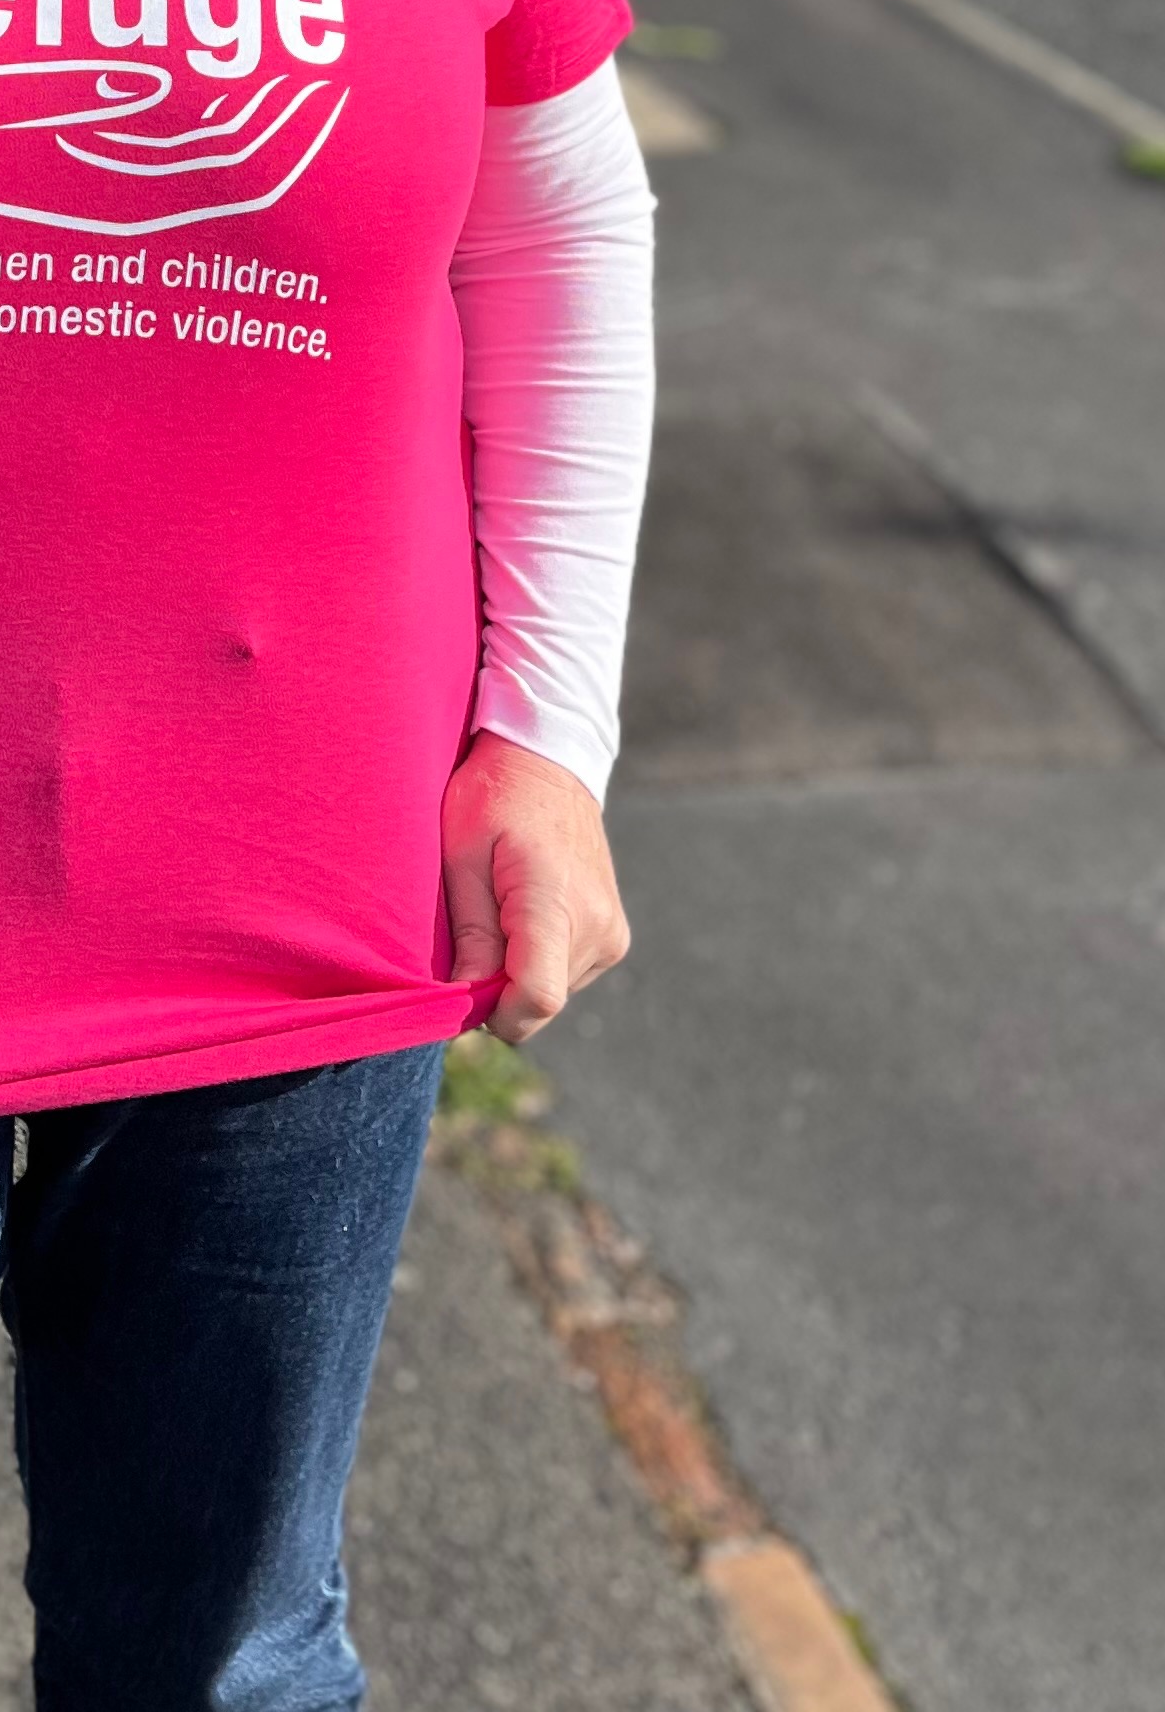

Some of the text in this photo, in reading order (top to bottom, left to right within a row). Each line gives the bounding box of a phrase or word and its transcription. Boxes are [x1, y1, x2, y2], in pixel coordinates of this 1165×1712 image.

[72, 249, 146, 284] and
[162, 252, 327, 303] children.
[174, 306, 331, 360] violence.
